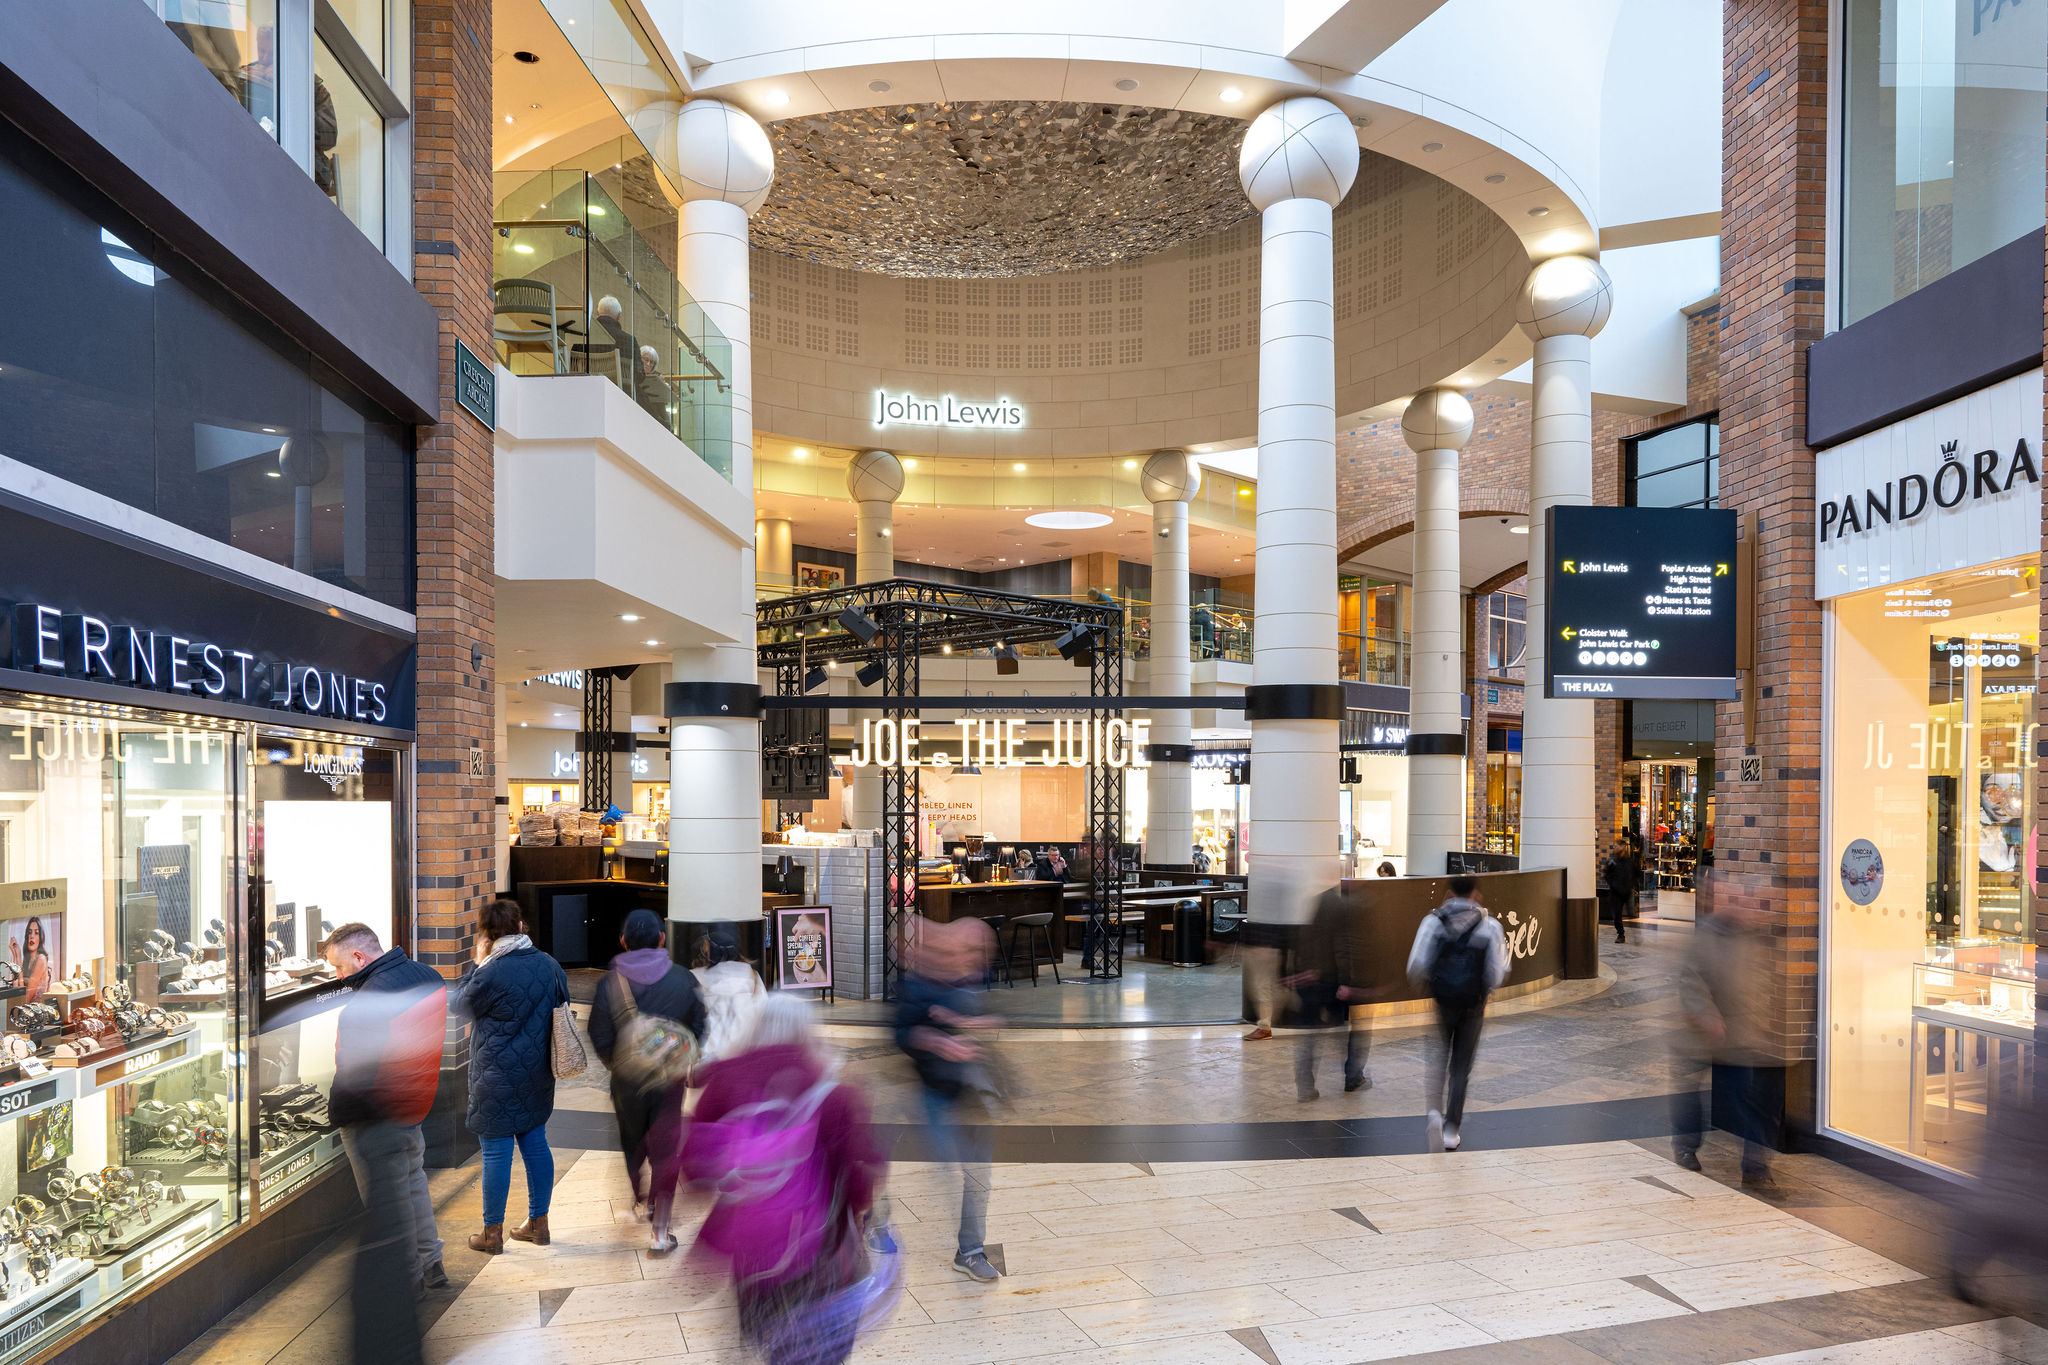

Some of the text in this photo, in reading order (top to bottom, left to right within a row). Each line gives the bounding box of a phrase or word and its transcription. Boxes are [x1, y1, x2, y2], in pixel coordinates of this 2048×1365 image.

[463, 360, 491, 396] CRESCENT
[467, 383, 489, 413] ARCADE
[876, 391, 1021, 425] John Lewis
[1820, 438, 2039, 543] PANDORA
[1579, 562, 1628, 573] John Lewis
[1661, 564, 1712, 574] Poplar Arcade
[1670, 575, 1712, 585] High Street
[1665, 585, 1712, 594] Station Road
[1663, 596, 1683, 604] Buses
[1692, 596, 1712, 604] Taxis
[1656, 606, 1712, 616] Solihull Station
[1580, 629, 1628, 638] Cloister Walk
[1579, 640, 1597, 649] John
[1598, 640, 1618, 648] Lewis
[1634, 640, 1650, 648] Park
[37, 604, 386, 722] ERNEST JONES
[1562, 682, 1614, 692] THE PLAZA
[1656, 720, 1687, 732] GEIGER
[852, 718, 1153, 768] JOE & THE JUICE
[1386, 727, 1410, 744] SWA
[304, 752, 363, 776] LONGINES
[21, 886, 57, 902] RADO
[124, 1050, 160, 1074] RADO
[259, 1153, 310, 1192] RNEST JONES
[62, 1271, 80, 1284] CITIZEN
[10, 1298, 30, 1316] CITIZEN
